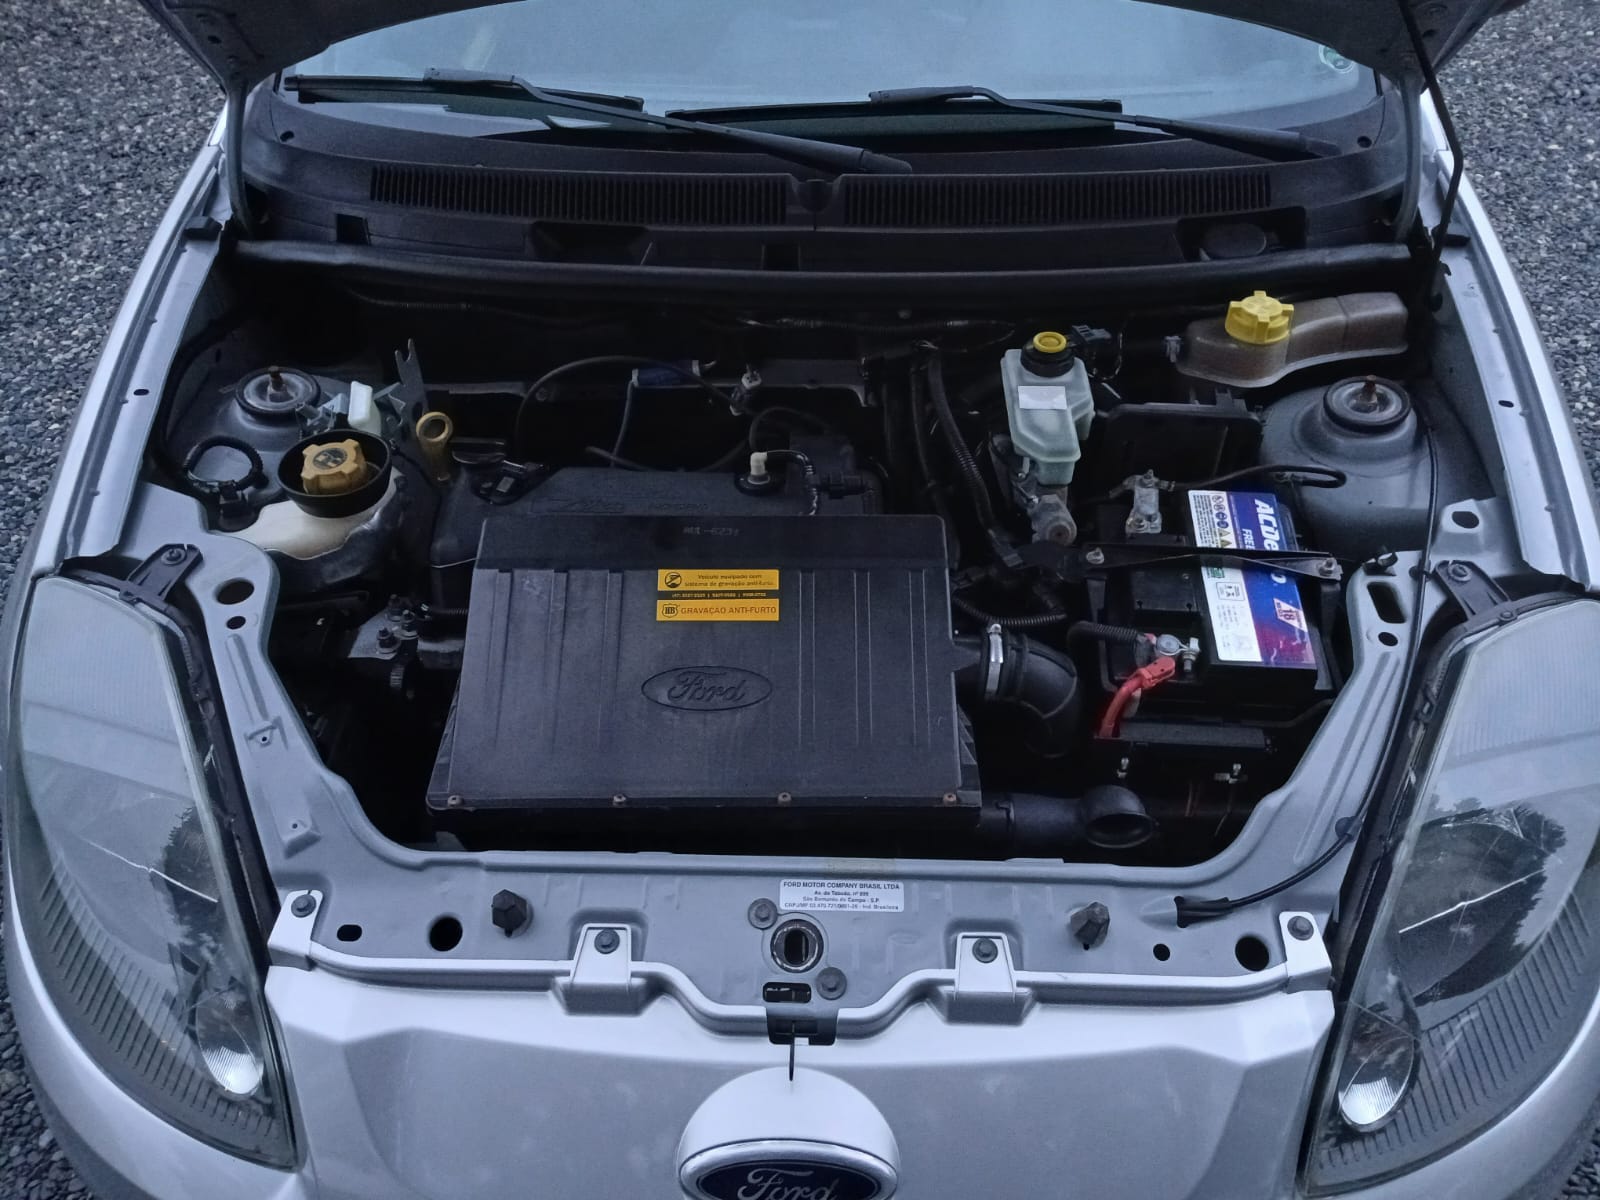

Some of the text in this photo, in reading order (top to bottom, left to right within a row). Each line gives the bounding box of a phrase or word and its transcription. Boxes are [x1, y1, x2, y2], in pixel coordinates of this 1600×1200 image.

[728, 606, 777, 614] ANTI-FURTO
[667, 670, 747, 702] Ford
[737, 1168, 840, 1200] Ford
